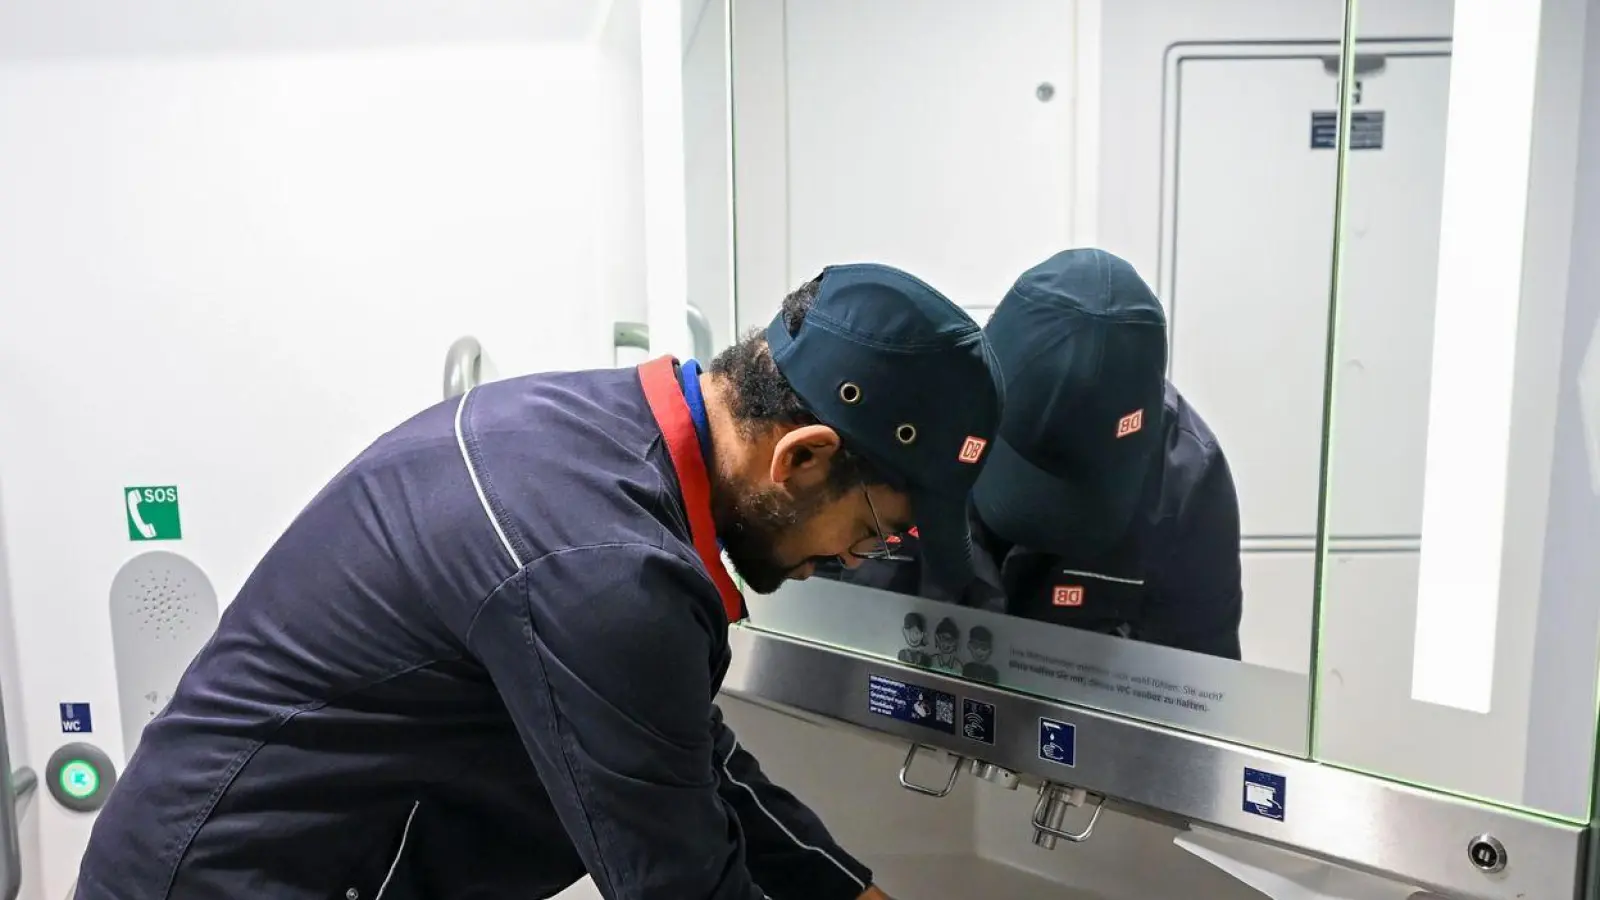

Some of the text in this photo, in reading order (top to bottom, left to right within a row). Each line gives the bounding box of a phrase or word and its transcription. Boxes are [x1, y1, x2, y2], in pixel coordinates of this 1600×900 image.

[961, 439, 984, 460] DB
[144, 488, 176, 502] SOS
[63, 721, 81, 731] WC
